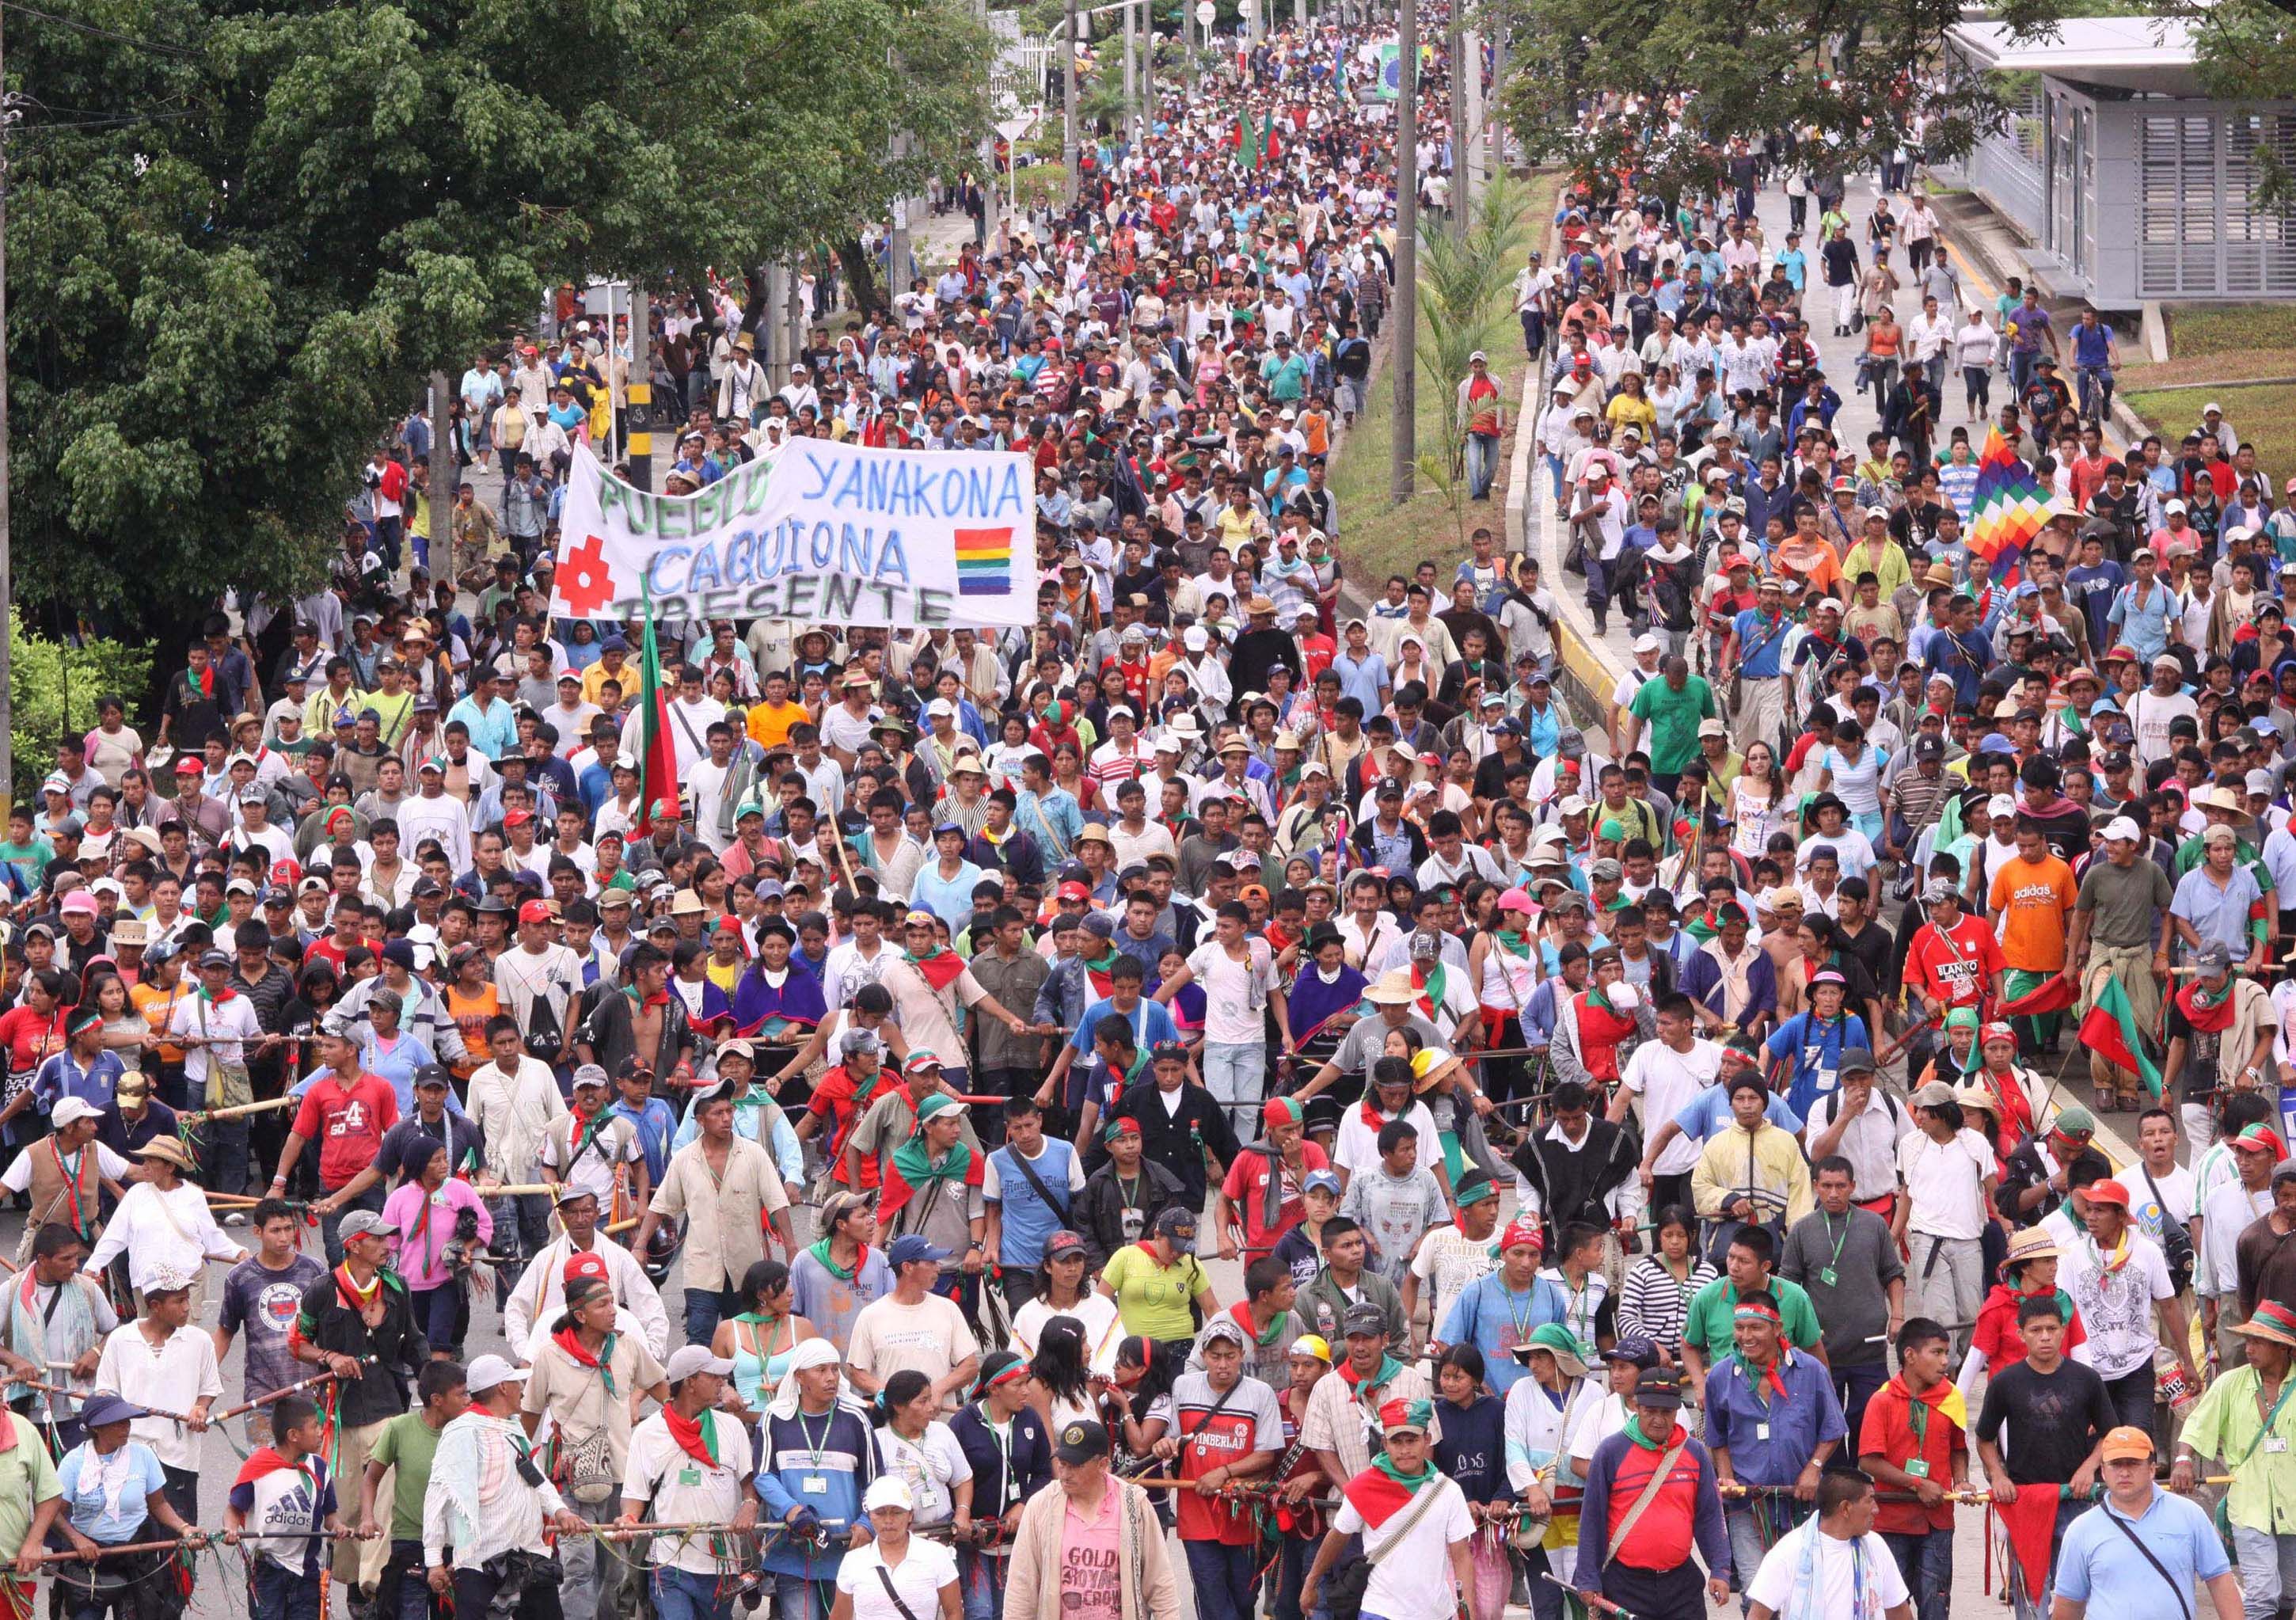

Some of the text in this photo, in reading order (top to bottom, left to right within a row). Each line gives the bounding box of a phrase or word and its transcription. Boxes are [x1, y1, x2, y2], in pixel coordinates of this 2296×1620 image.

[597, 452, 1024, 538] PUEBLO YANAKONA
[645, 517, 912, 596] CAQUIONA
[610, 573, 957, 626] PRESENTE
[2014, 884, 2051, 899] adidas
[1937, 961, 1977, 975] BLANO
[264, 1513, 312, 1527] adidas
[1069, 1546, 1116, 1568] GOLD
